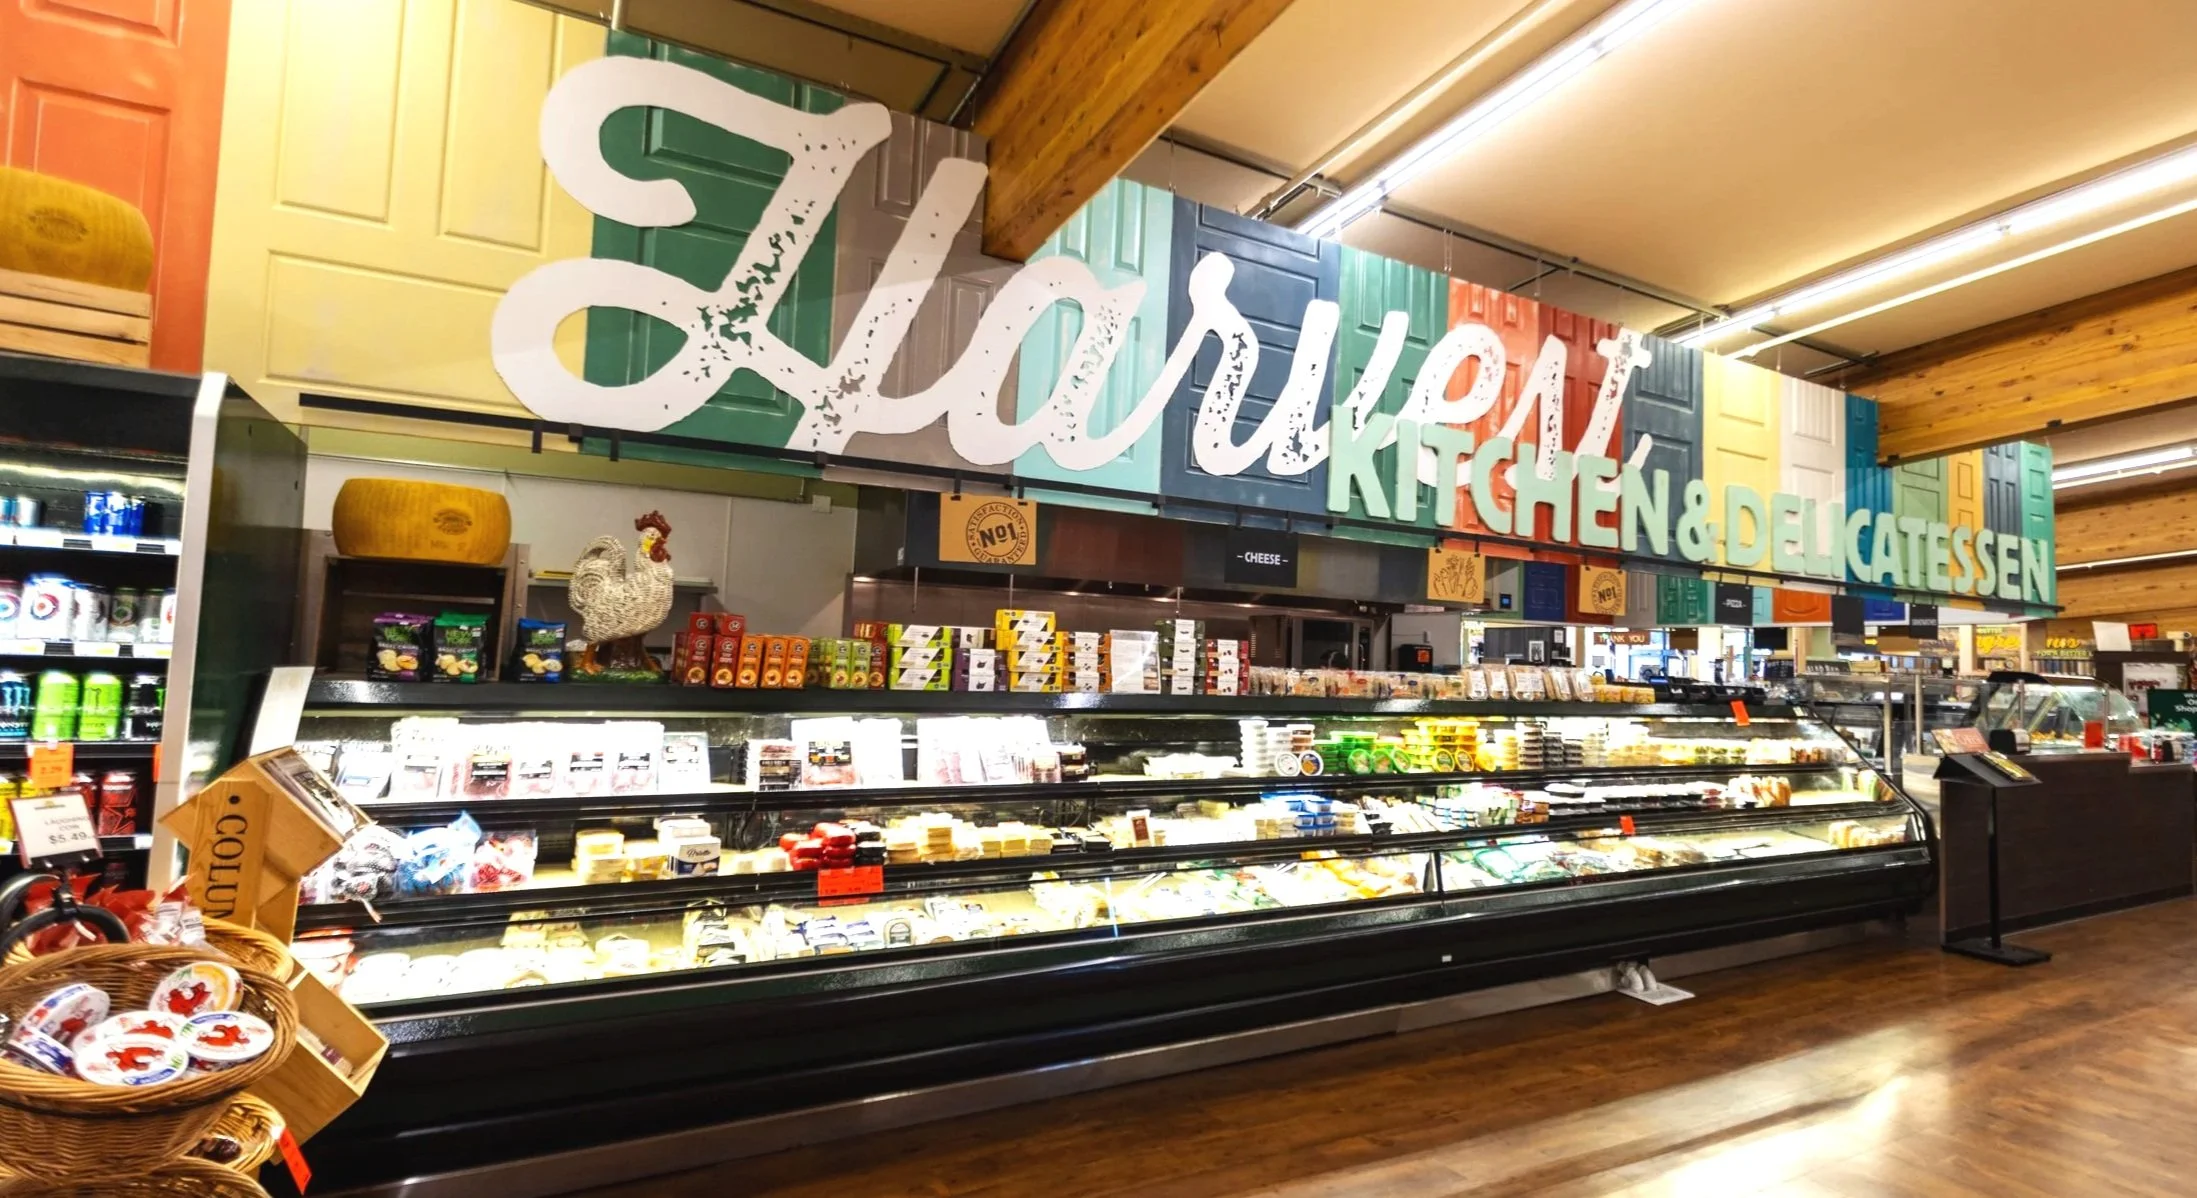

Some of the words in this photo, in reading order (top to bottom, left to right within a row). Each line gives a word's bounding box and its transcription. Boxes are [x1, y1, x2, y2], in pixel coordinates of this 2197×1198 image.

[491, 56, 1652, 492] Harvest
[967, 504, 1023, 540] SATISFACTION
[1327, 406, 1670, 556] KITCHEN
[1676, 479, 1718, 562] &
[1724, 485, 2050, 603] DELICATESSEN
[1244, 552, 1281, 565] CHEESE
[1629, 634, 1646, 643] YOU
